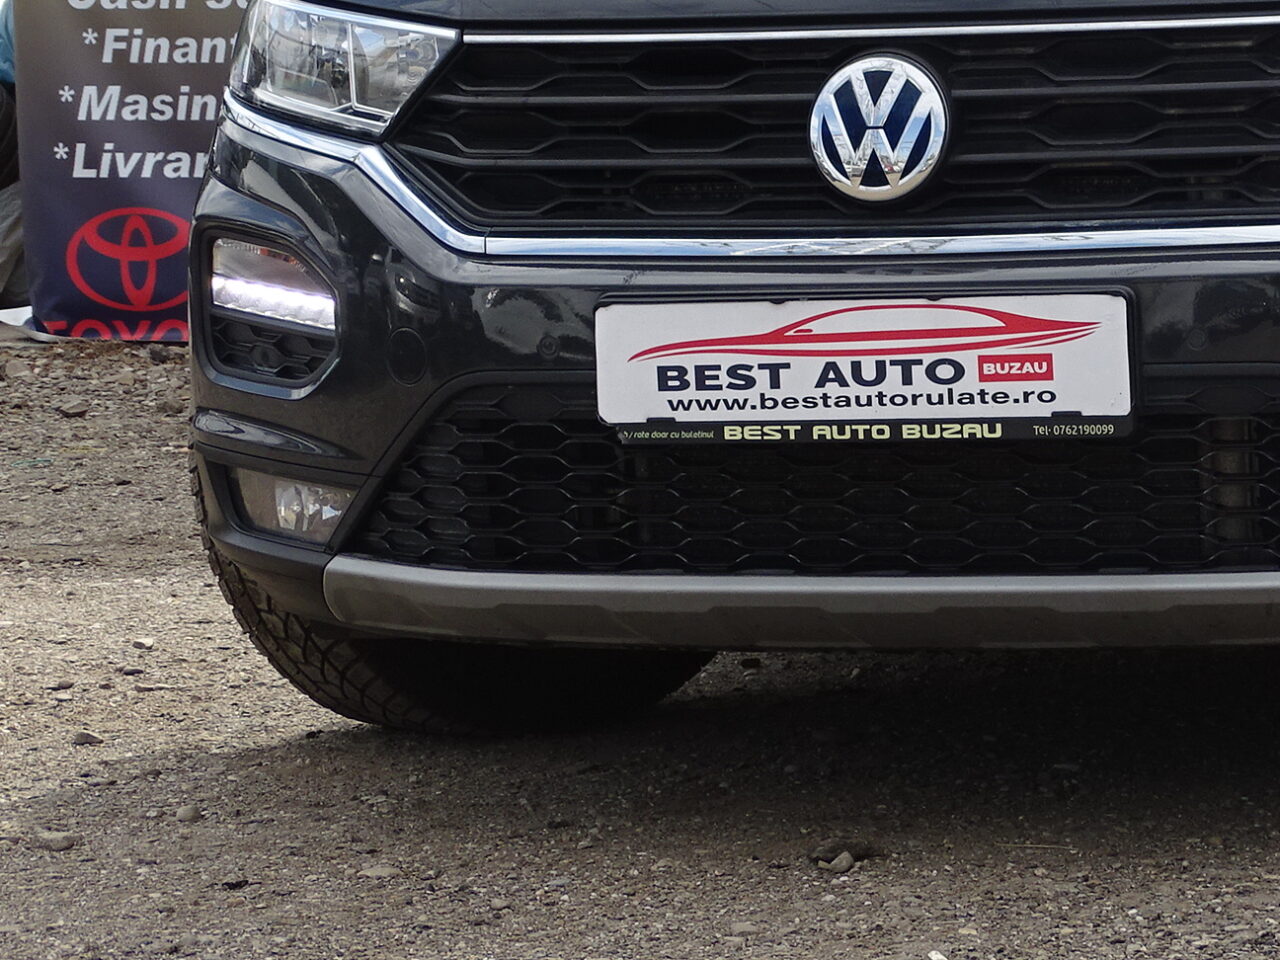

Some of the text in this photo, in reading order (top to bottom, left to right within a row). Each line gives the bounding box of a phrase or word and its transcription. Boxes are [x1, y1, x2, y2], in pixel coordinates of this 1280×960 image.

[657, 358, 1048, 391] BEST AUTO BUZAU
[667, 388, 1057, 411] www.bestautorulate.ro
[723, 423, 1002, 440] BEST AUTO BUZAU
[1053, 424, 1115, 436] 0762190099
